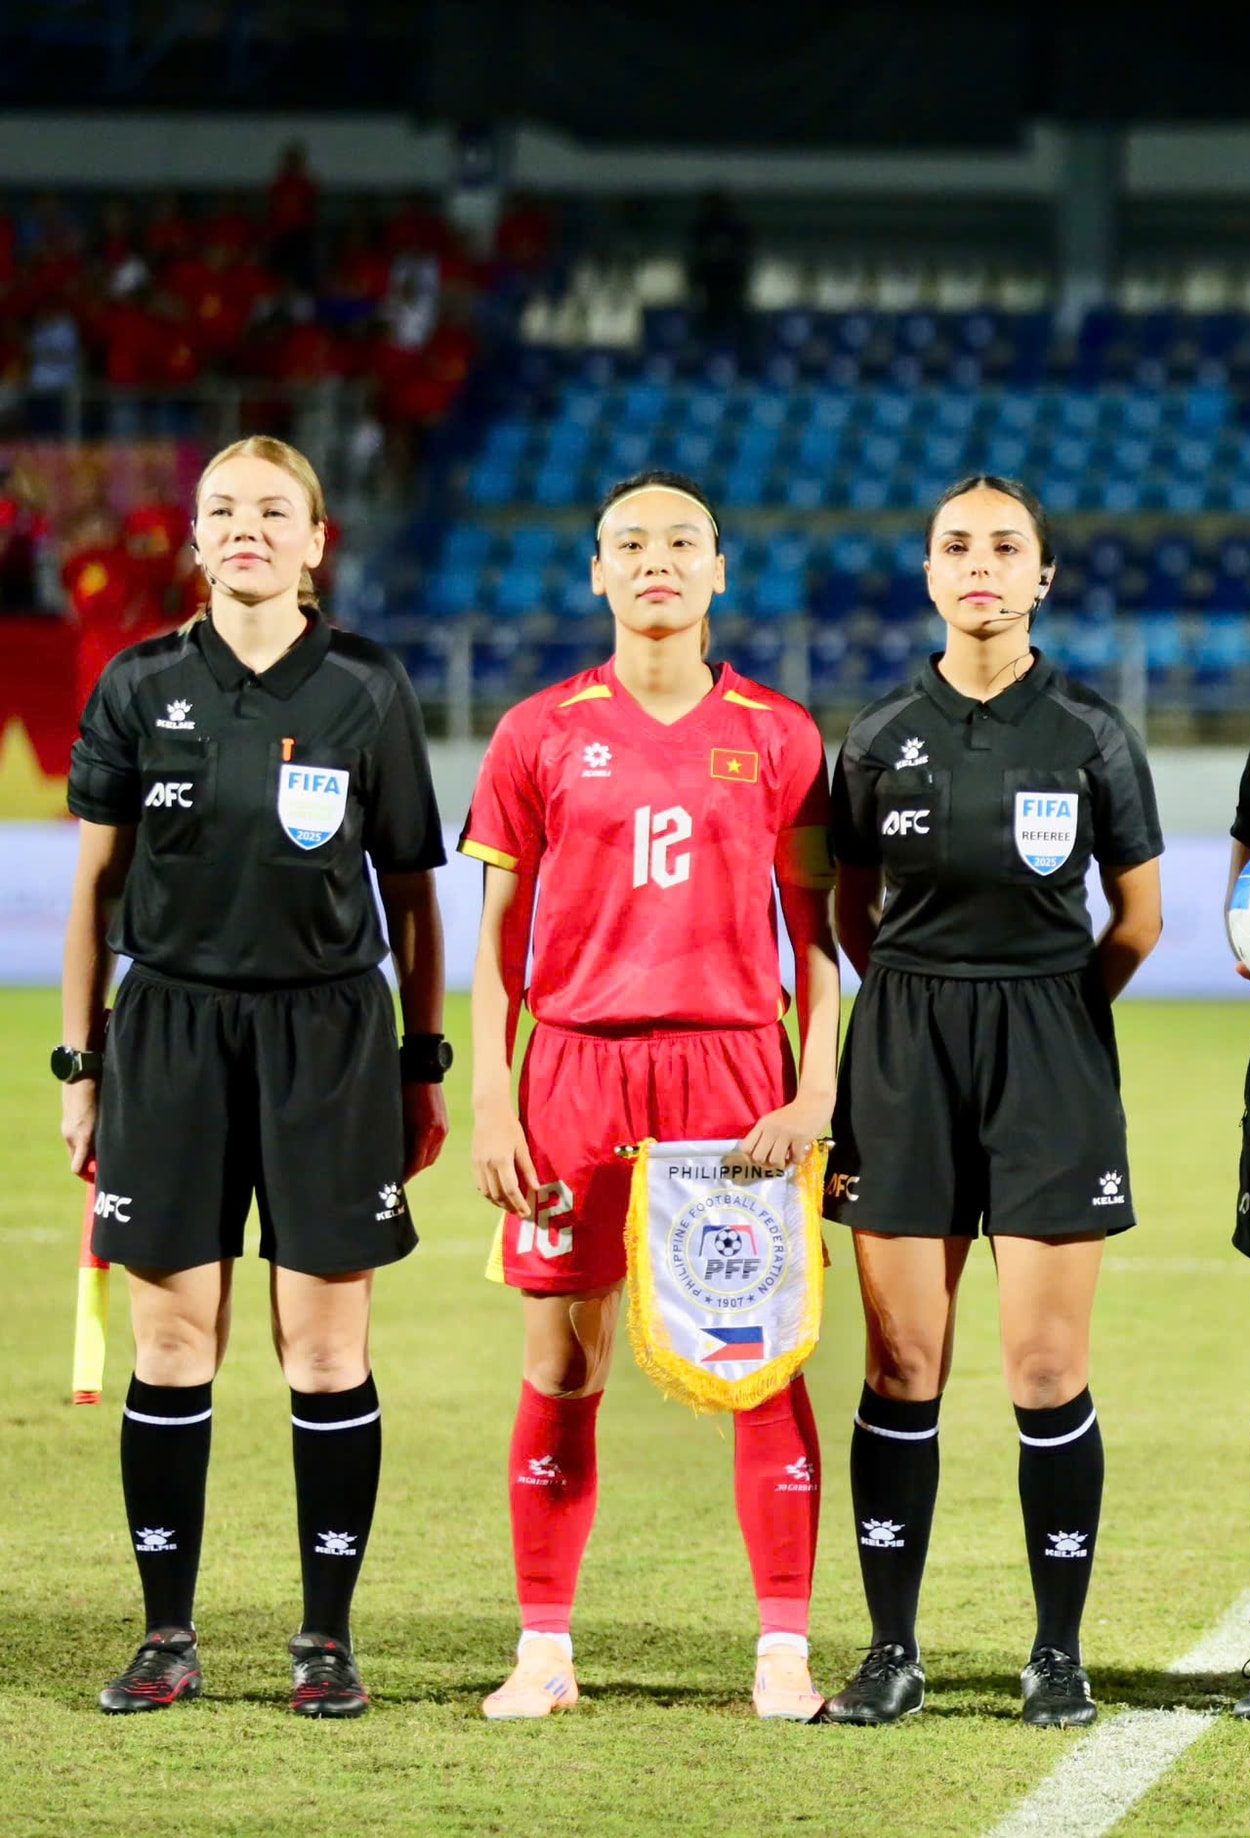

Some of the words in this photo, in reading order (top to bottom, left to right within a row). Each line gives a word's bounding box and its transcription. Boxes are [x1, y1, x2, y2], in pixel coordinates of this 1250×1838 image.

[287, 771, 341, 795] FIFA
[145, 782, 193, 808] AFC
[1022, 799, 1072, 818] FIFA
[881, 810, 931, 836] AFC
[296, 830, 322, 842] 2025
[1022, 830, 1072, 841] REFEREE
[632, 804, 692, 889] 12
[1034, 857, 1057, 868] 2025
[672, 1219, 703, 1298] PHILIPPINE
[688, 1194, 757, 1218] FOOTBALL
[757, 1210, 785, 1295] FEDERATION
[704, 1259, 761, 1280] PFF
[717, 1297, 744, 1308] 1907
